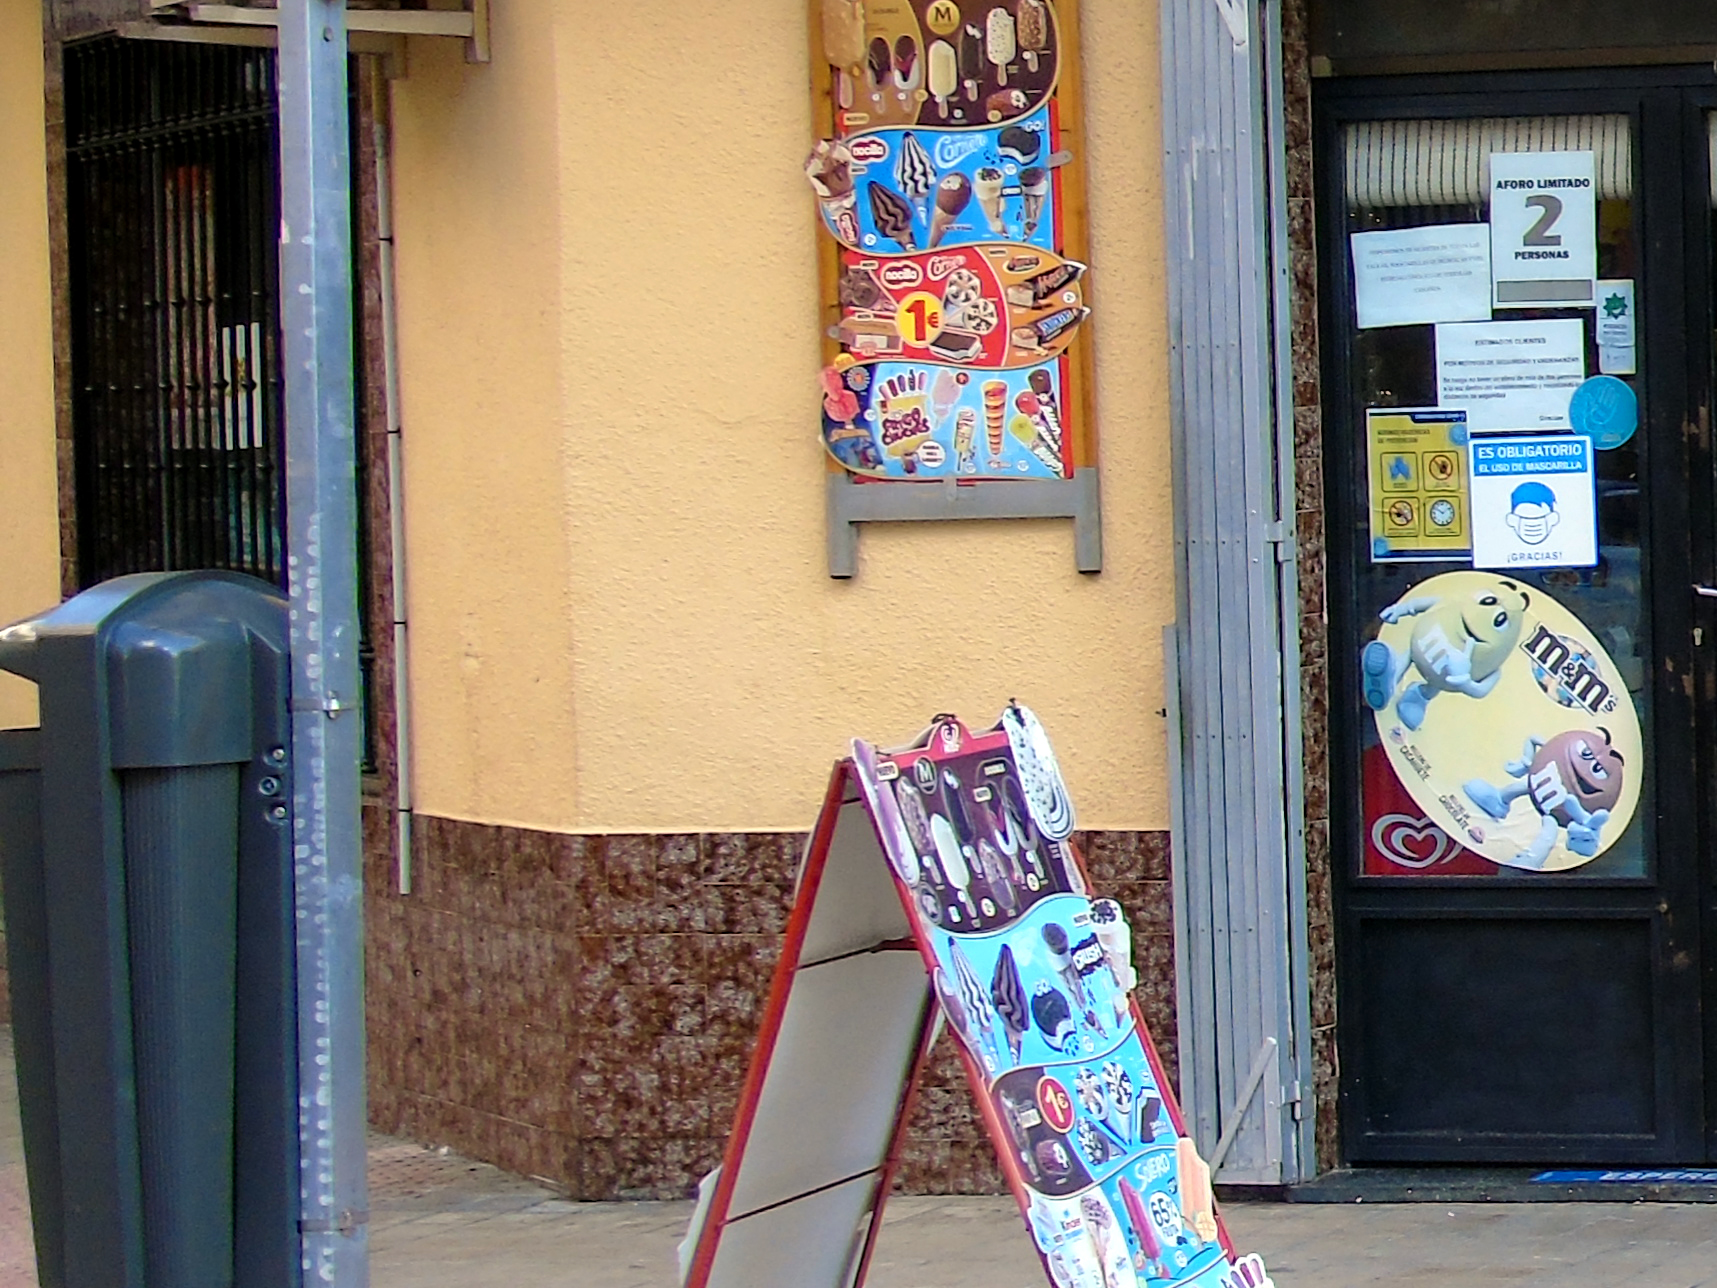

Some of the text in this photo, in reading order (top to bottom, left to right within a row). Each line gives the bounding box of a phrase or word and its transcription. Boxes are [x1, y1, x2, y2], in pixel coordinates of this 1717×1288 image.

[1495, 178, 1591, 190] AFORO LIMITADO
[1522, 194, 1564, 247] 2
[1513, 250, 1570, 261] PERSONAS
[1478, 443, 1583, 459] ES OBLIGATORIO
[1478, 460, 1583, 473] EL USO DE MASCARILLA
[1506, 551, 1563, 564] ¡GRACIAS!
[1044, 1084, 1069, 1123] 1€
[1150, 1197, 1178, 1228] 65%
